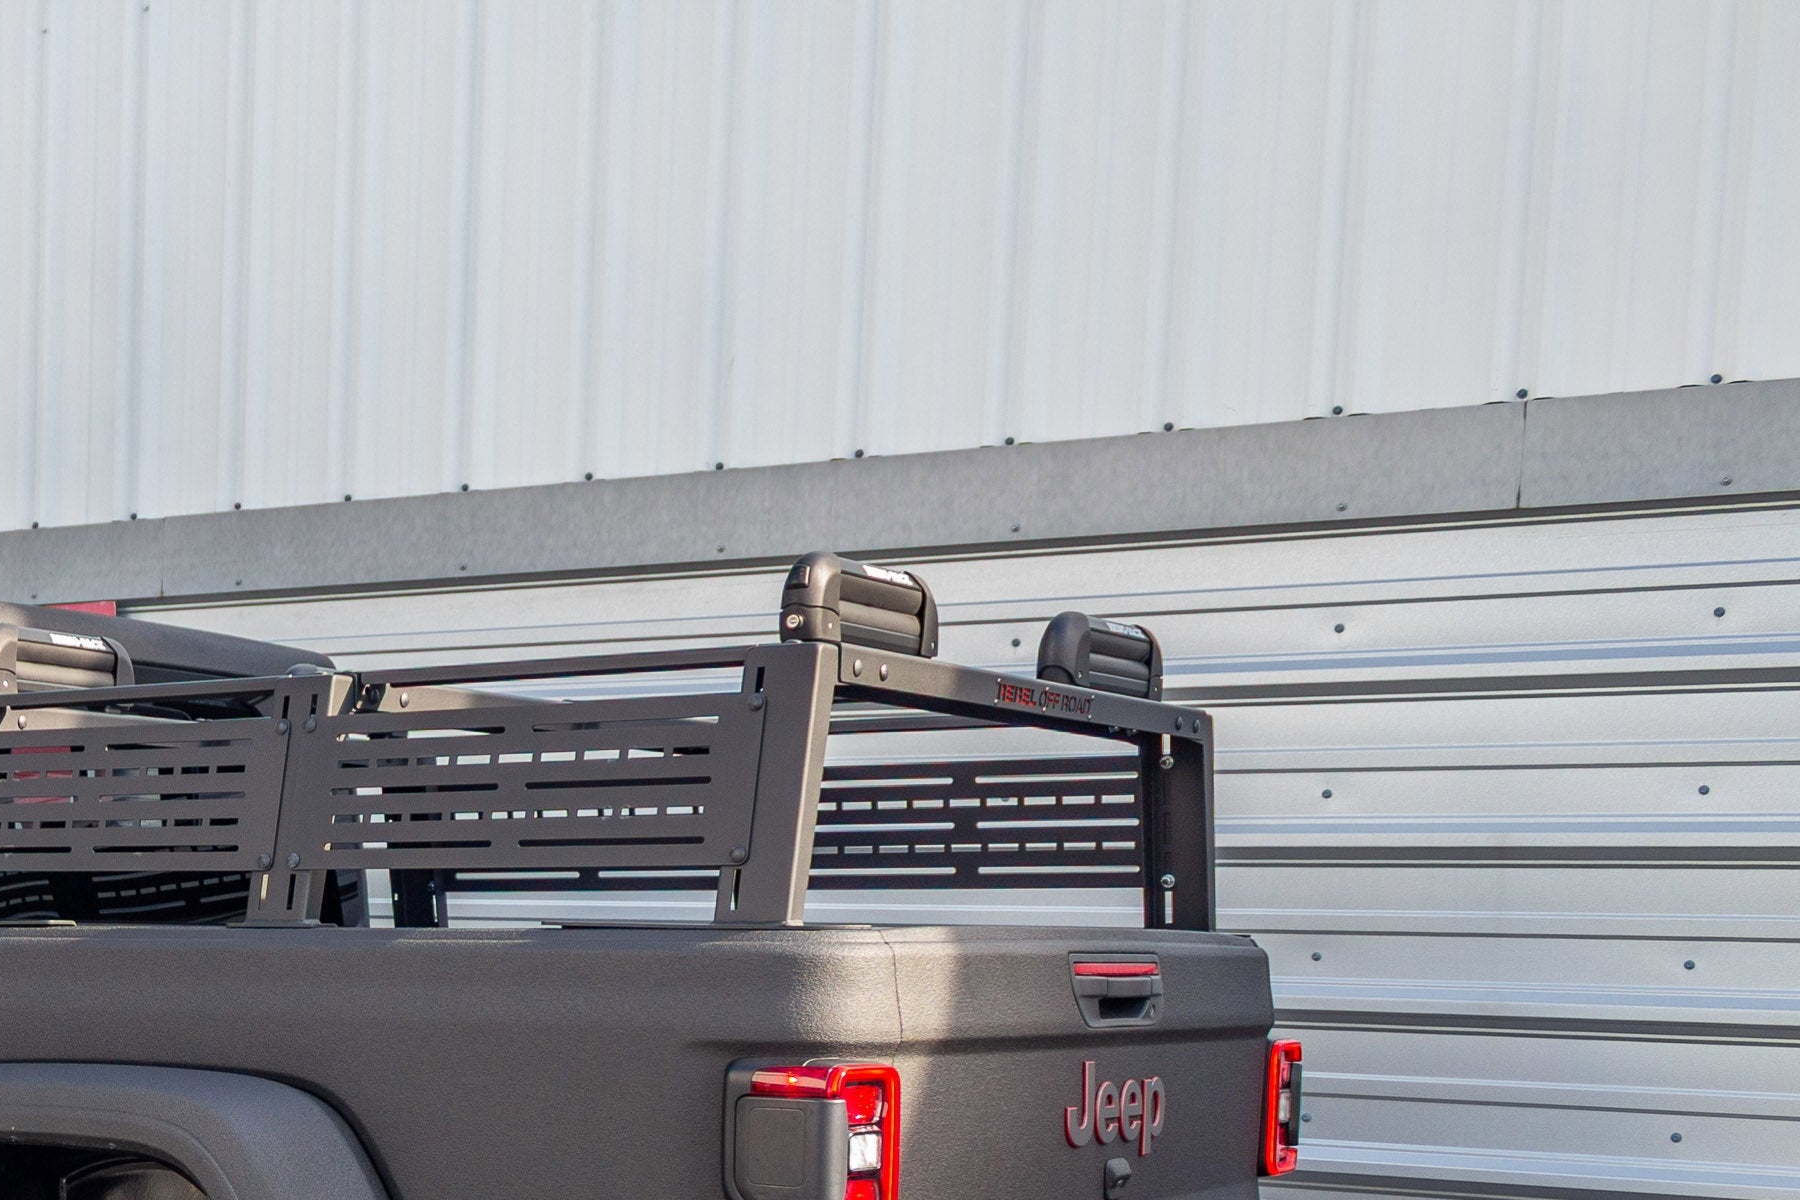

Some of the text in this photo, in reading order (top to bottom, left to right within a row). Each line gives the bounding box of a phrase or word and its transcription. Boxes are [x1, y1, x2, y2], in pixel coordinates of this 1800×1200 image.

[997, 683, 1092, 714] REBEL OFF ROAD
[1064, 1060, 1166, 1157] Jeep
